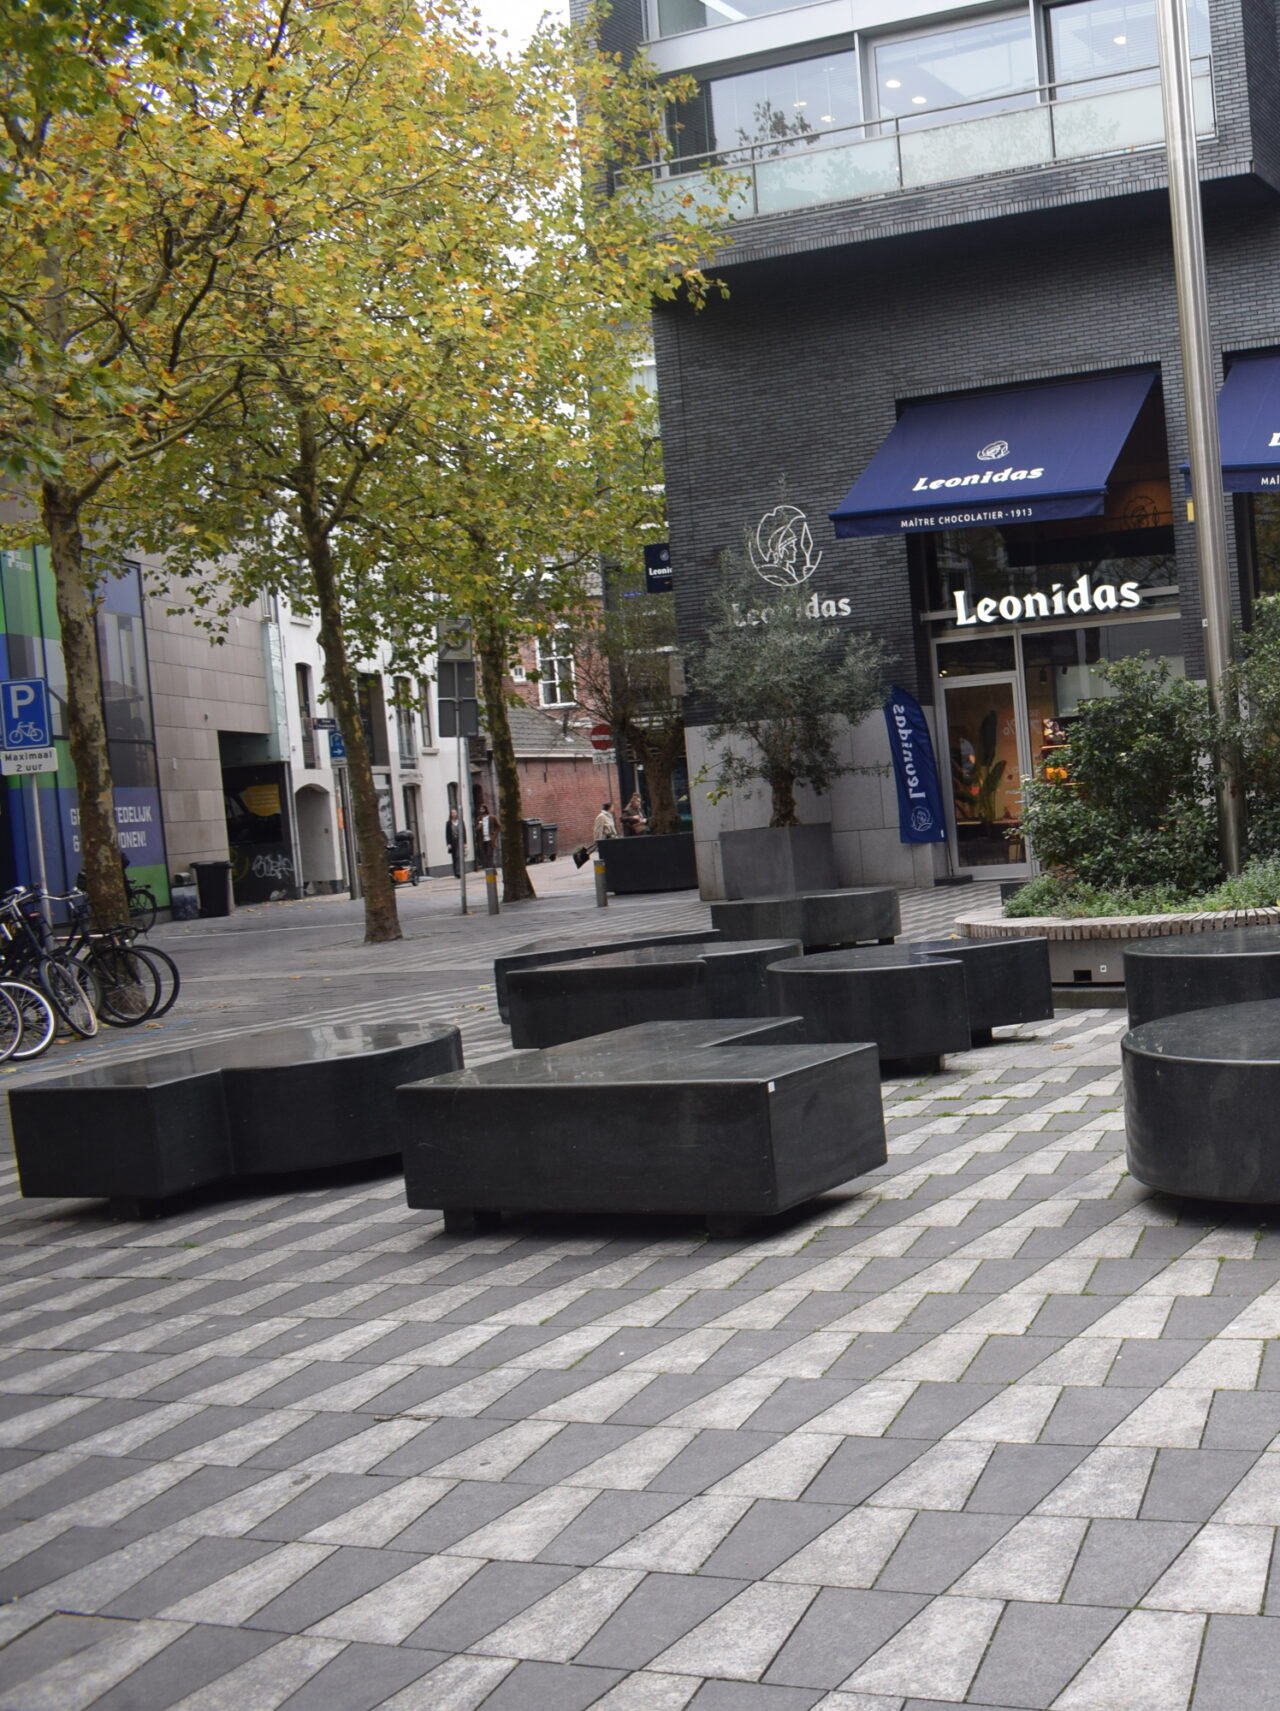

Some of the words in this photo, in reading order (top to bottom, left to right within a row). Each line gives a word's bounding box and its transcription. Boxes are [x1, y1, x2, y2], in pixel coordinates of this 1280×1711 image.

[912, 467, 1045, 492] Leonidas
[901, 516, 935, 529] MAÎTRE
[938, 511, 1004, 525] CHOCOLATIER
[1011, 507, 1033, 518] 1913
[953, 574, 1141, 626] Leonidas
[10, 684, 35, 719] P
[5, 750, 52, 761] Maximaal
[16, 764, 23, 772] 2
[25, 763, 42, 771] uur
